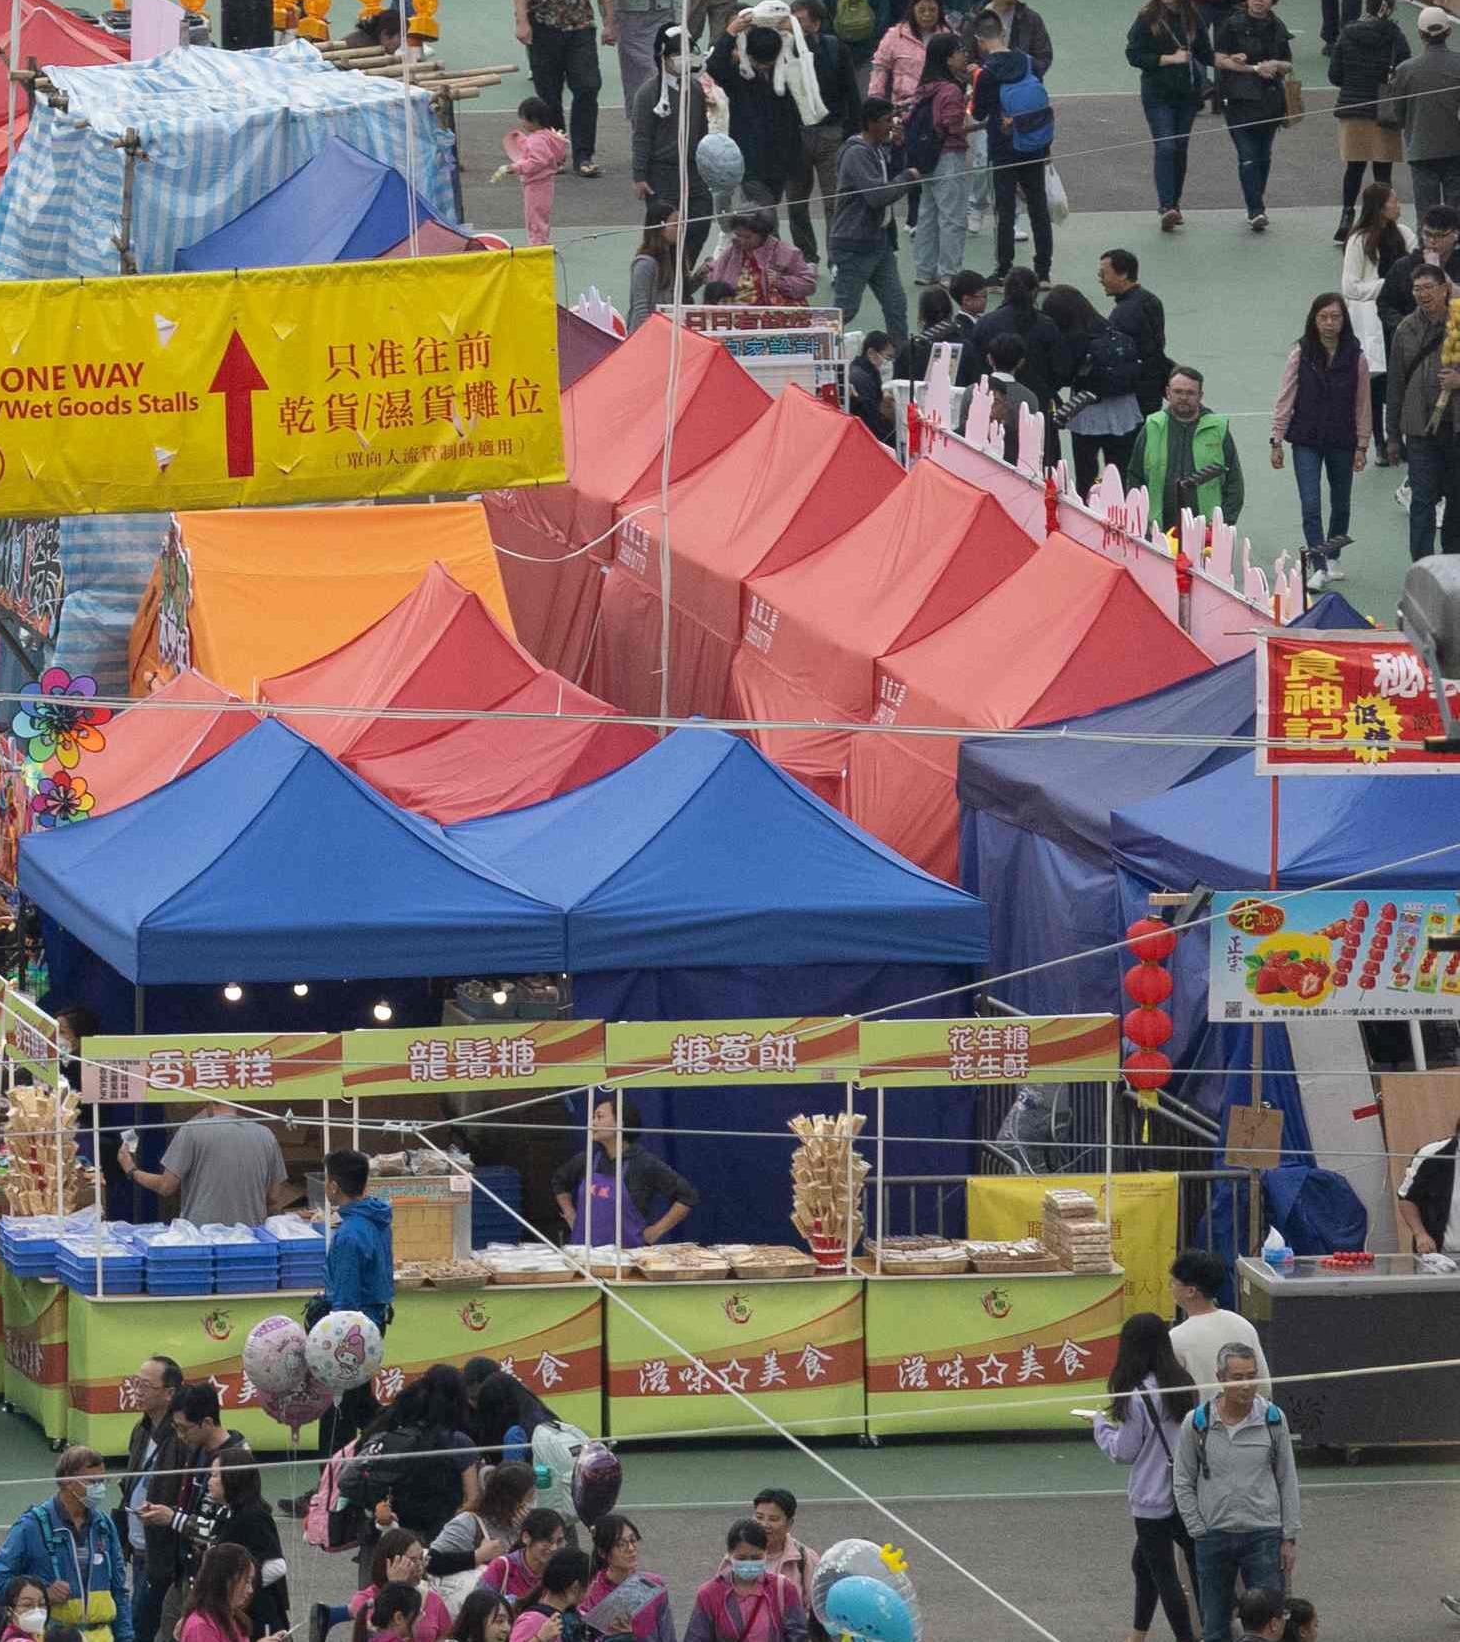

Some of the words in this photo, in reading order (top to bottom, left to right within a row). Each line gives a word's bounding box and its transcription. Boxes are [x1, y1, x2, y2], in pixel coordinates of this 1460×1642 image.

[324, 330, 492, 381] 只准往前
[0, 366, 67, 393] ONE
[72, 362, 145, 389] WAY
[58, 394, 132, 417] Goods
[138, 390, 199, 414] Stalls
[277, 377, 543, 436] 乾貨/濕貨攤位
[1283, 649, 1346, 750] 食神記
[408, 1037, 536, 1082] 龍鬚糖
[949, 1024, 1030, 1052] 花生糖
[149, 1047, 274, 1090] 香蕉糕
[949, 1052, 1030, 1082] 花生酥
